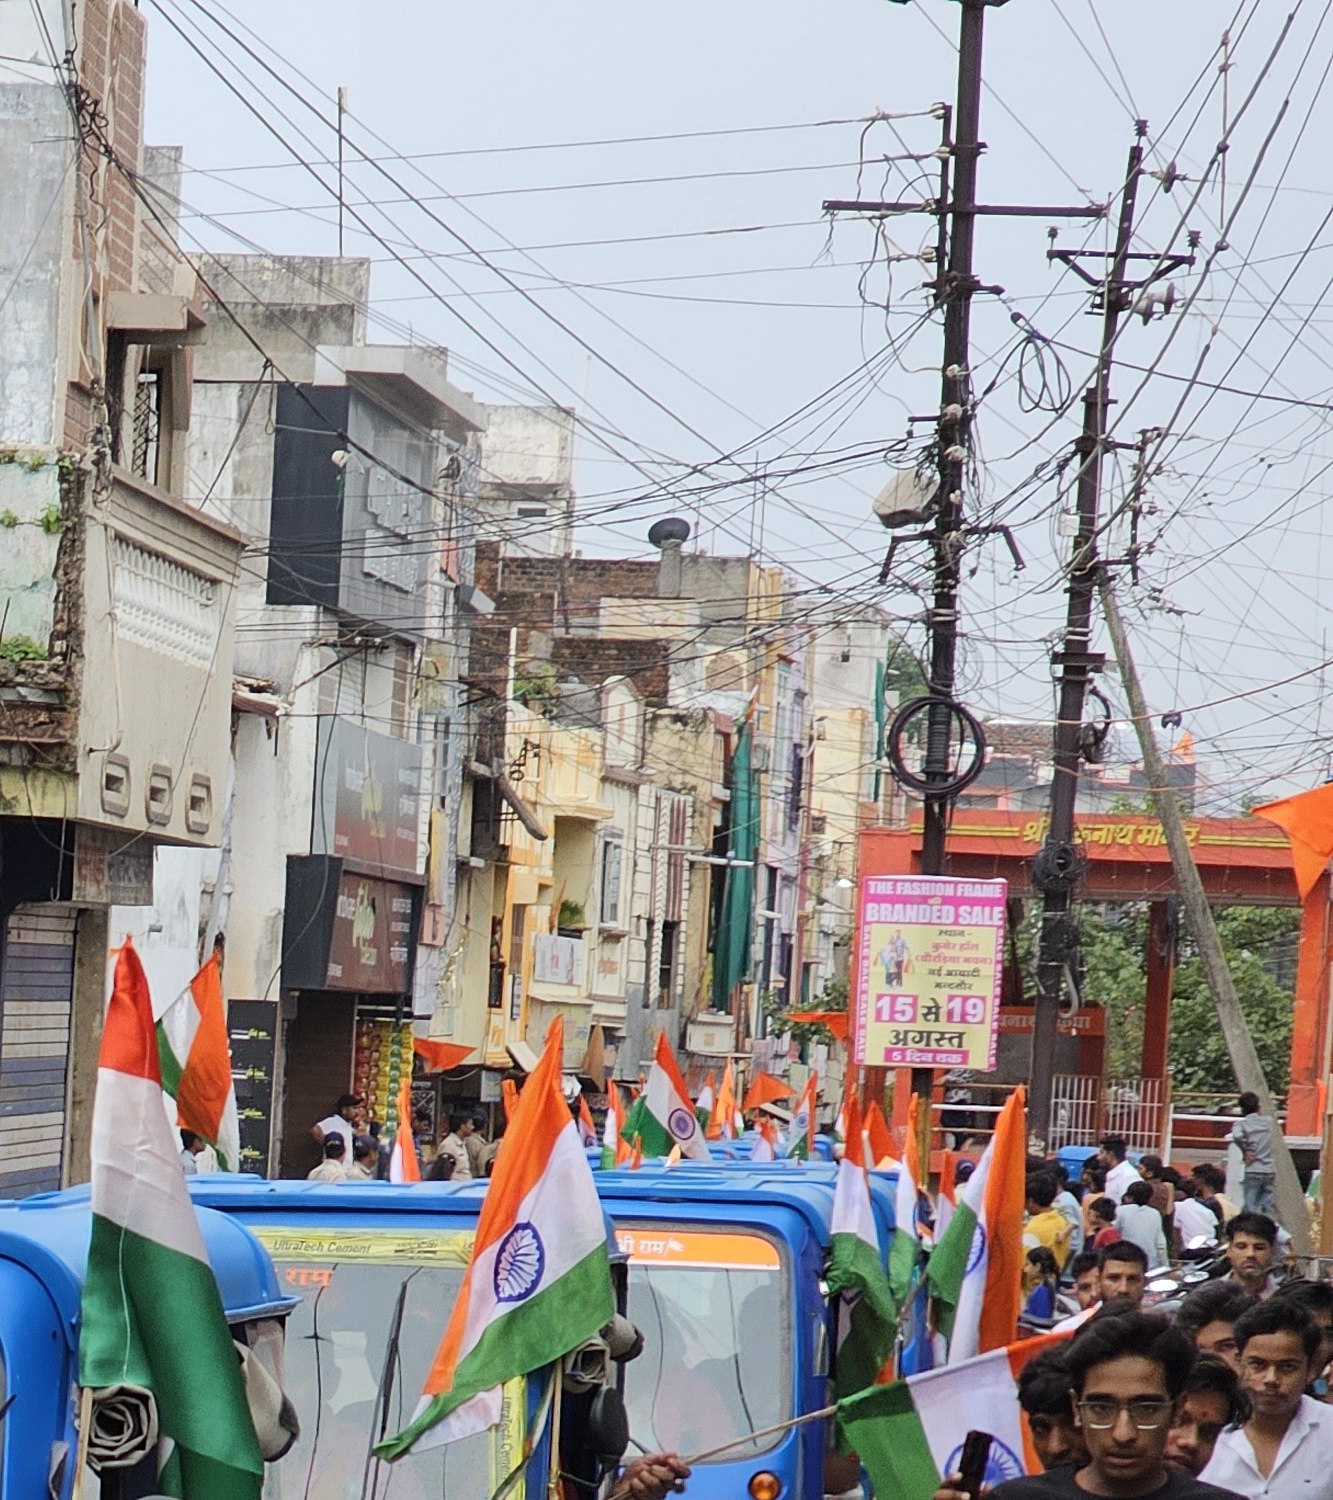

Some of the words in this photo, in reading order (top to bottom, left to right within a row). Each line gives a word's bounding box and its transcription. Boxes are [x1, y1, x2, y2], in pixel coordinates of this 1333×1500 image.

[868, 881, 894, 894] THE
[896, 881, 954, 896] FASHION
[957, 883, 1002, 897] FRAME
[866, 903, 955, 924] BRANDED
[958, 906, 1004, 925] SALE
[877, 996, 914, 1022] 15
[921, 998, 942, 1023] से
[948, 997, 984, 1023] 19
[889, 1030, 966, 1048] अगस्त
[273, 1240, 324, 1252] UltraTech
[327, 1241, 371, 1254] Cement
[285, 1268, 335, 1287] राम
